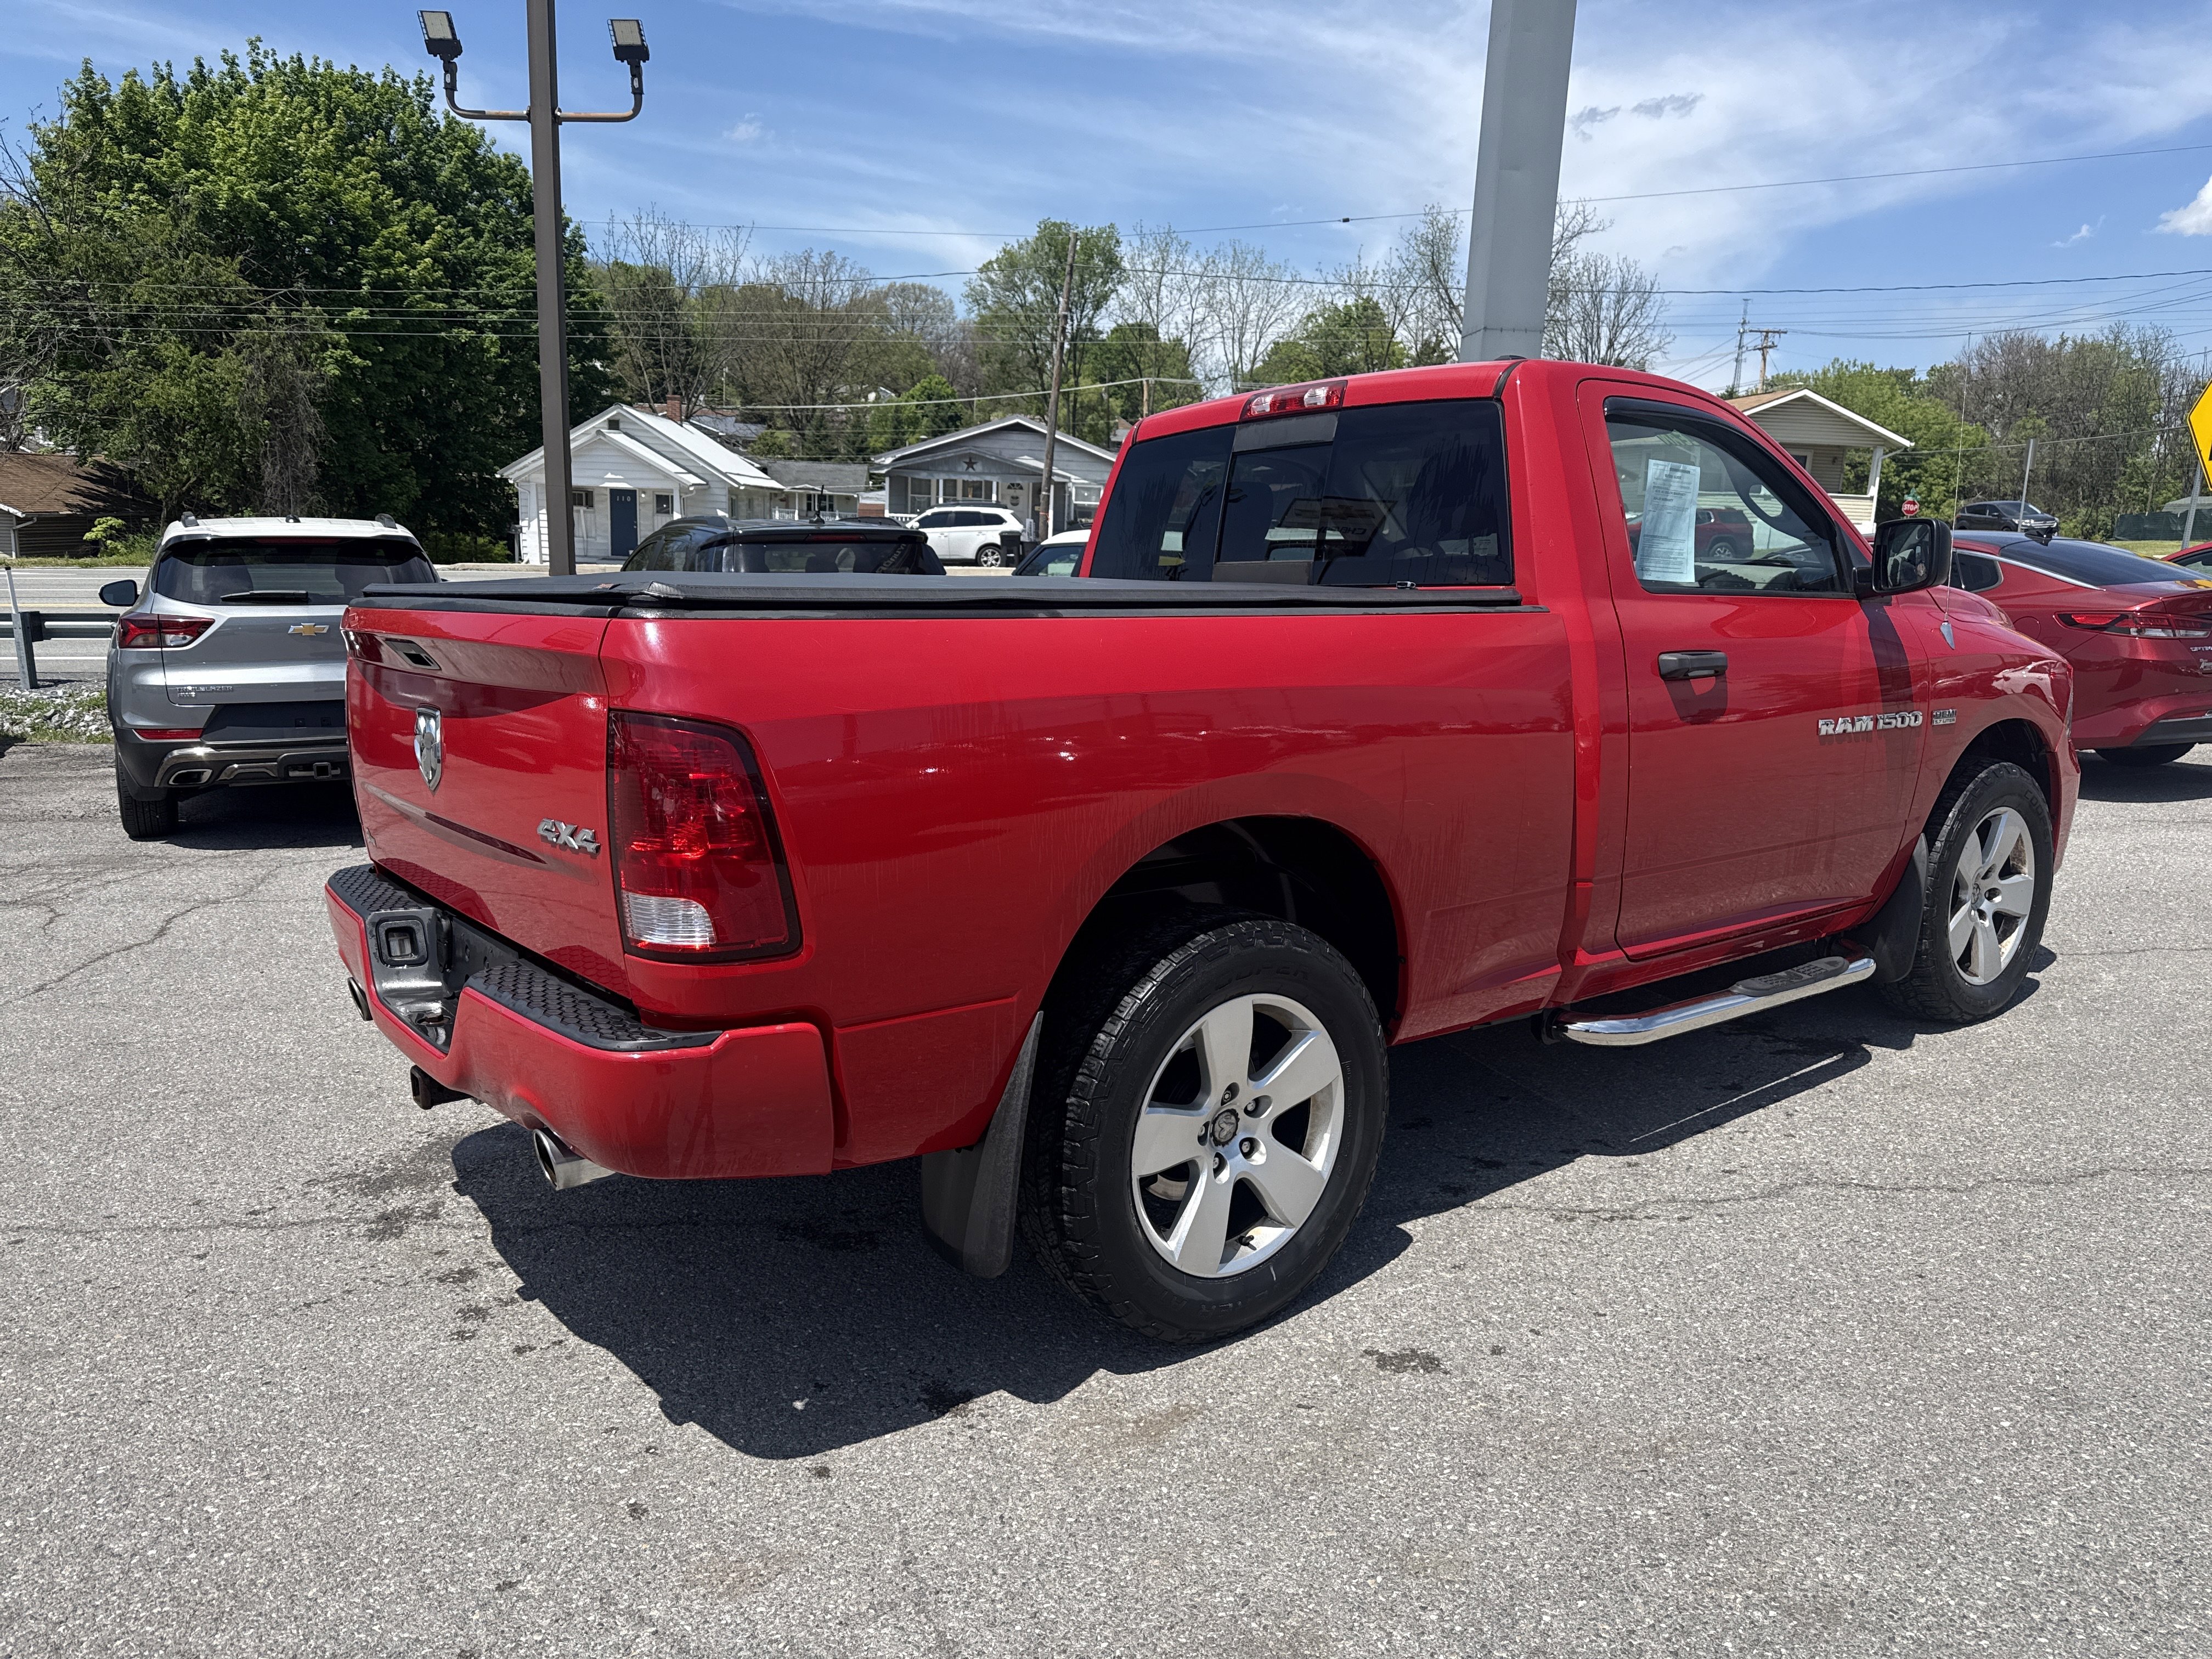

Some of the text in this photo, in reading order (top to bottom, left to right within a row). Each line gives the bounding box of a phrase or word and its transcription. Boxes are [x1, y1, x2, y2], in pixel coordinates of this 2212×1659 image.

[1933, 709, 1957, 718] HEMI
[1818, 711, 1923, 736] RAM 1500
